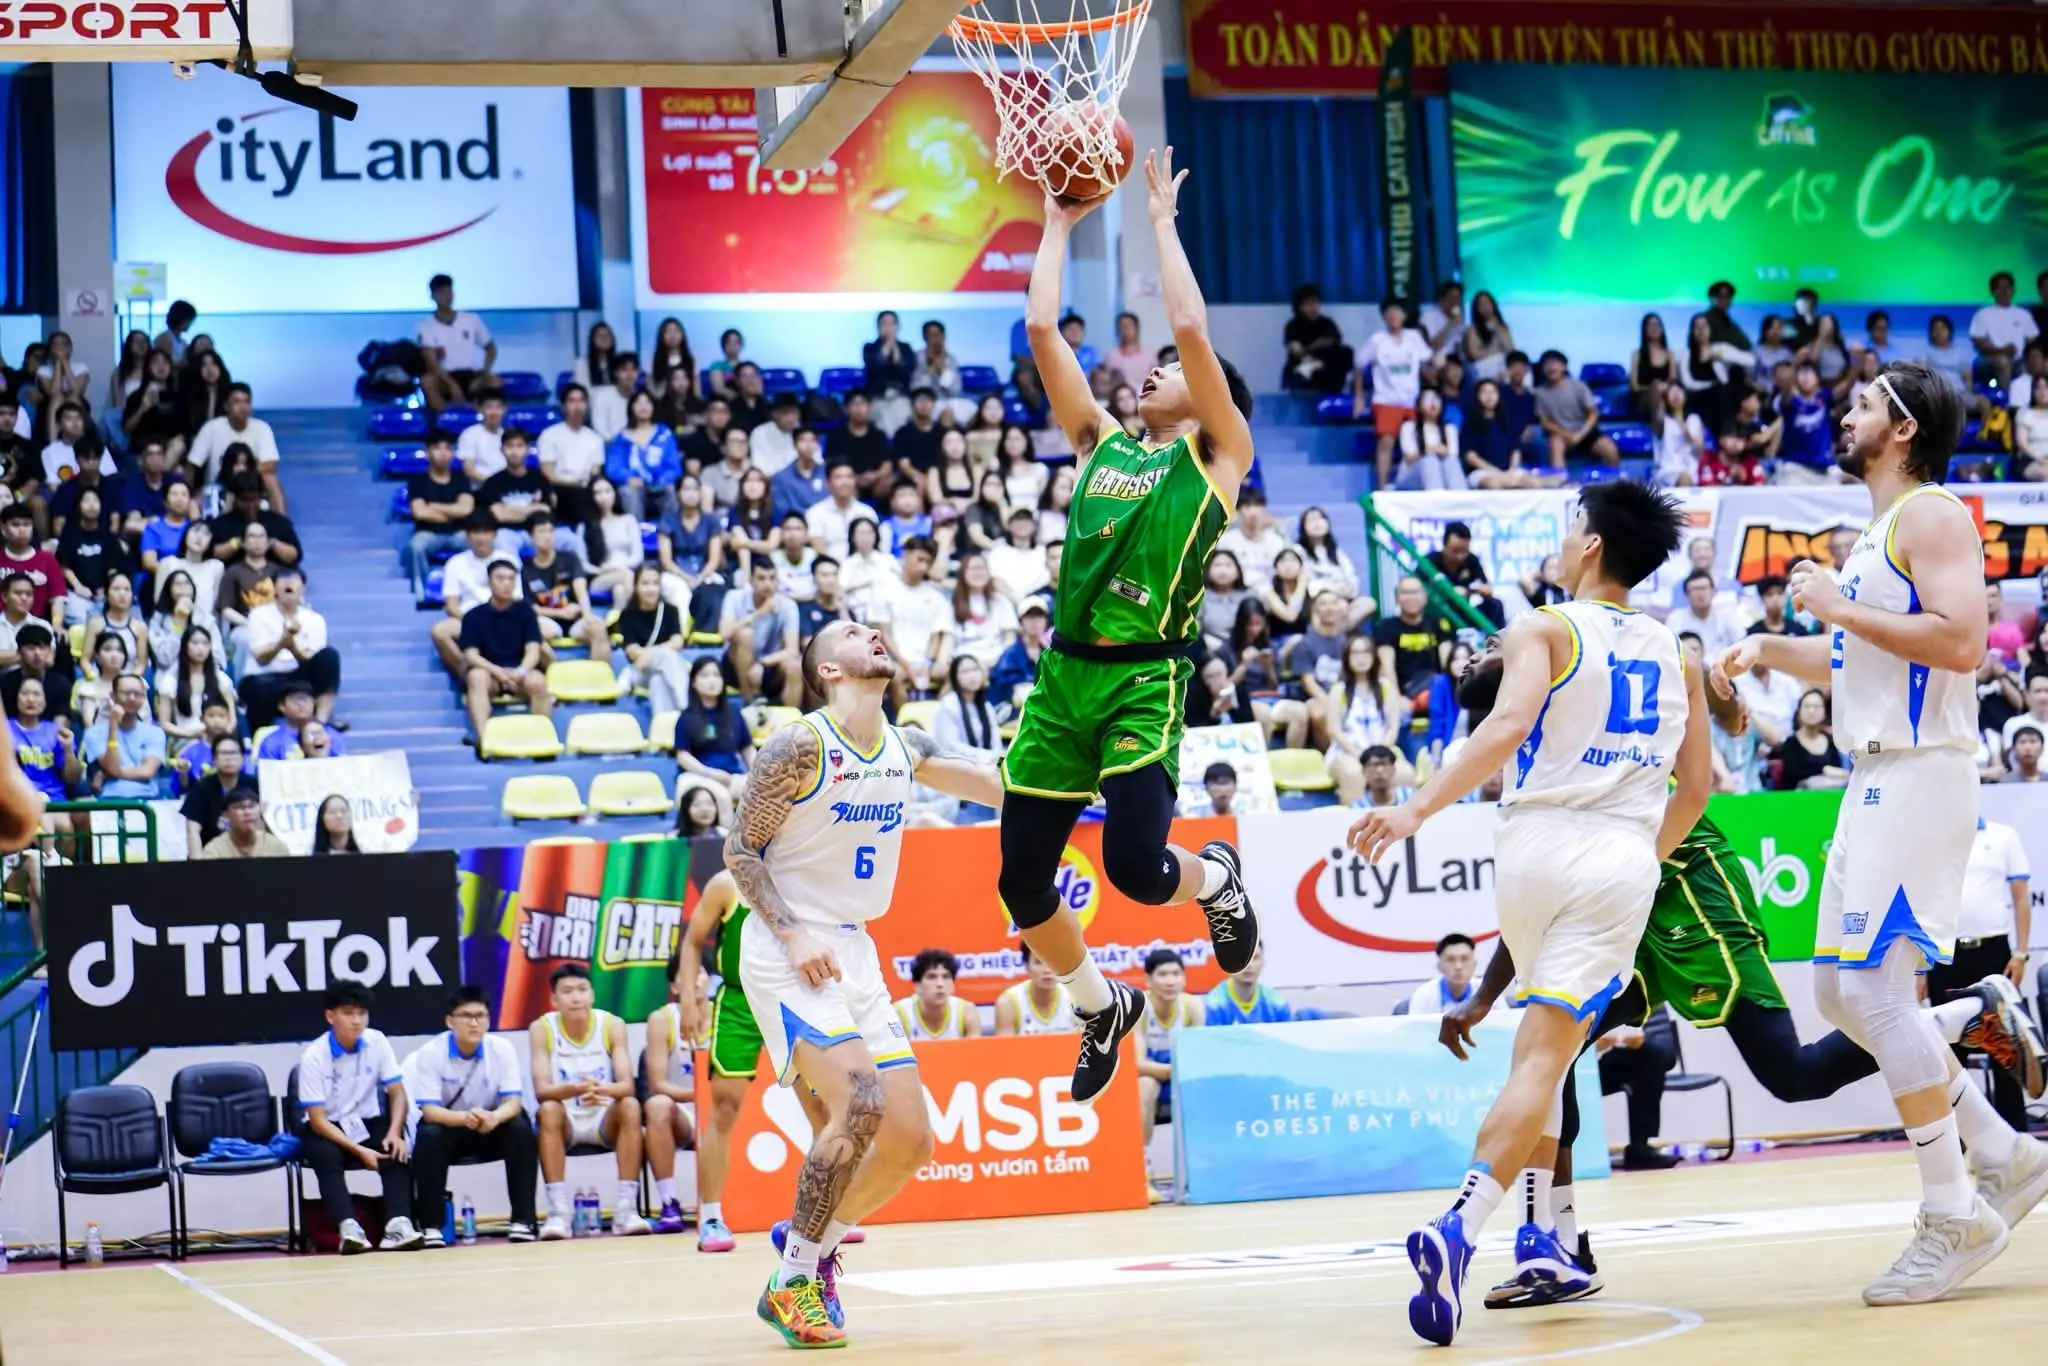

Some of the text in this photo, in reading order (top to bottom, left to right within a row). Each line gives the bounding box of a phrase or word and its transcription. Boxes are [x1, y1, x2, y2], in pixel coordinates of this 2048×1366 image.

[1218, 11, 1319, 66] TOÀN
[2010, 22, 2048, 73] BÁ
[1555, 129, 1764, 240] Flow
[1857, 135, 2015, 239] One
[843, 772, 860, 781] MSB
[854, 846, 876, 880] 6
[167, 916, 444, 997] TikTok
[919, 1074, 1100, 1153] MSB
[1270, 1092, 1318, 1112] THE
[1426, 1083, 1501, 1104] VILLA
[1235, 1115, 1332, 1139] FOREST
[1349, 1113, 1395, 1132] BAY
[916, 1160, 973, 1182] cùng
